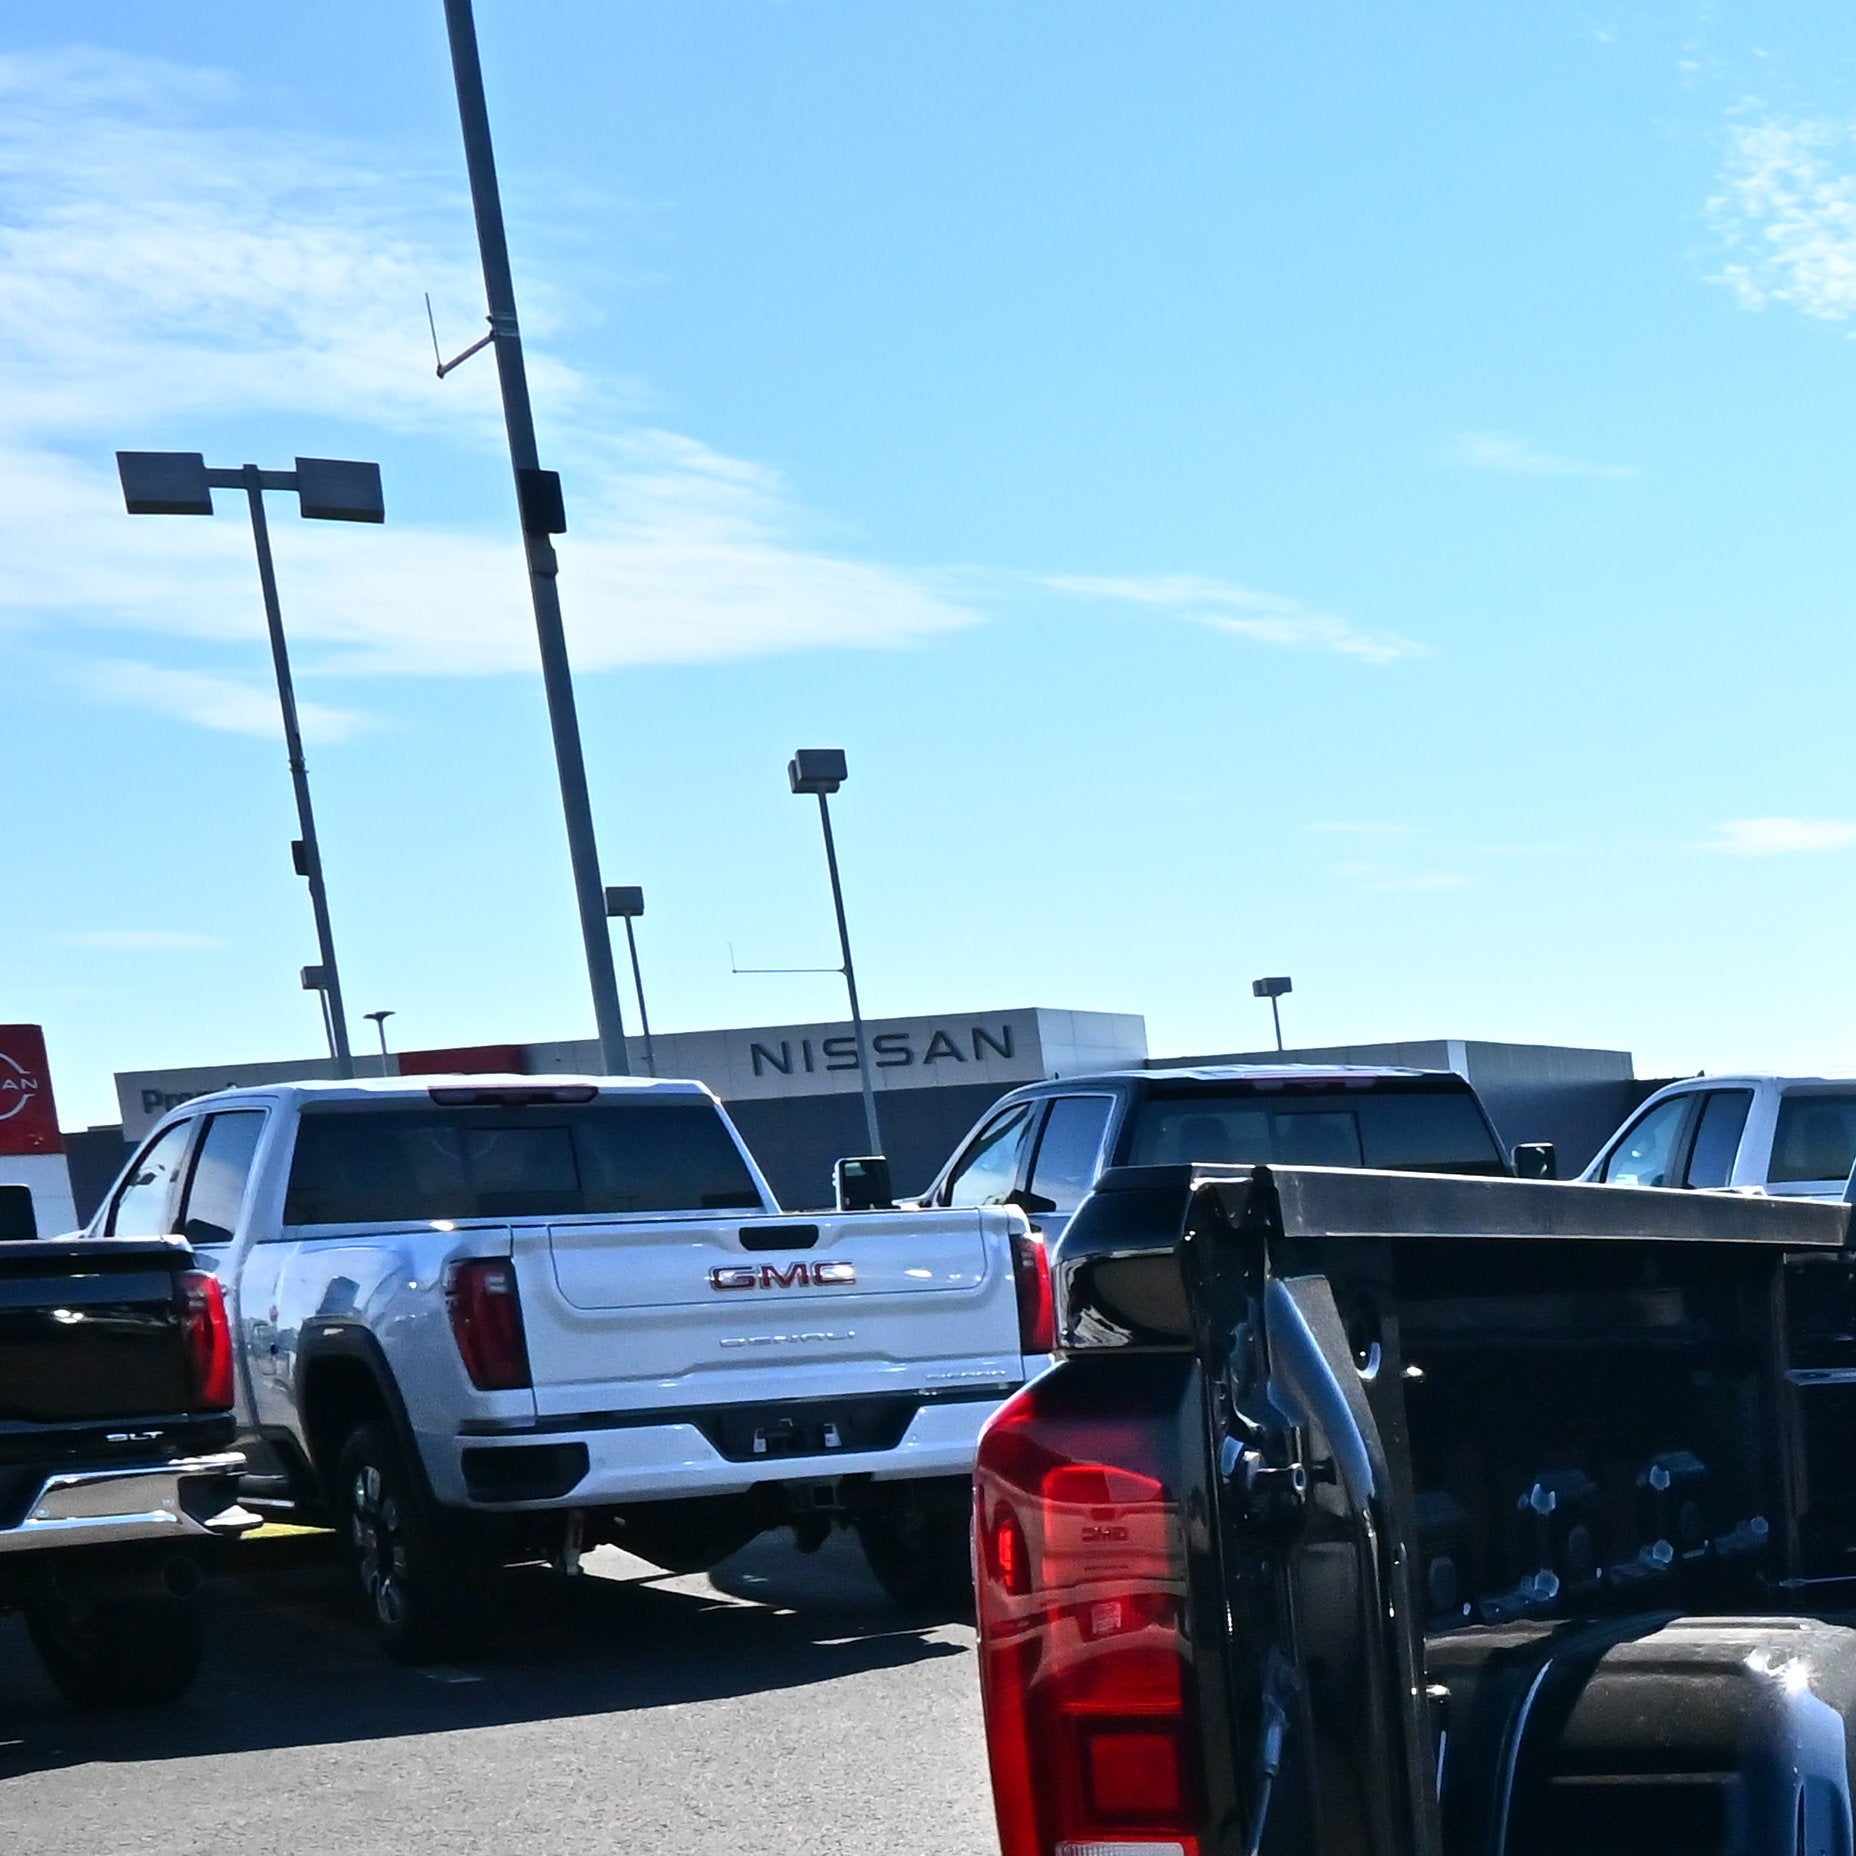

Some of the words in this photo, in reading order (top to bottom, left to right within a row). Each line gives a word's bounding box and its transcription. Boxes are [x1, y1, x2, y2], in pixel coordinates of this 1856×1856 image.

[750, 1024, 1016, 1077] NISSAN
[708, 1260, 856, 1291] GMC
[105, 1430, 164, 1442] SLT
